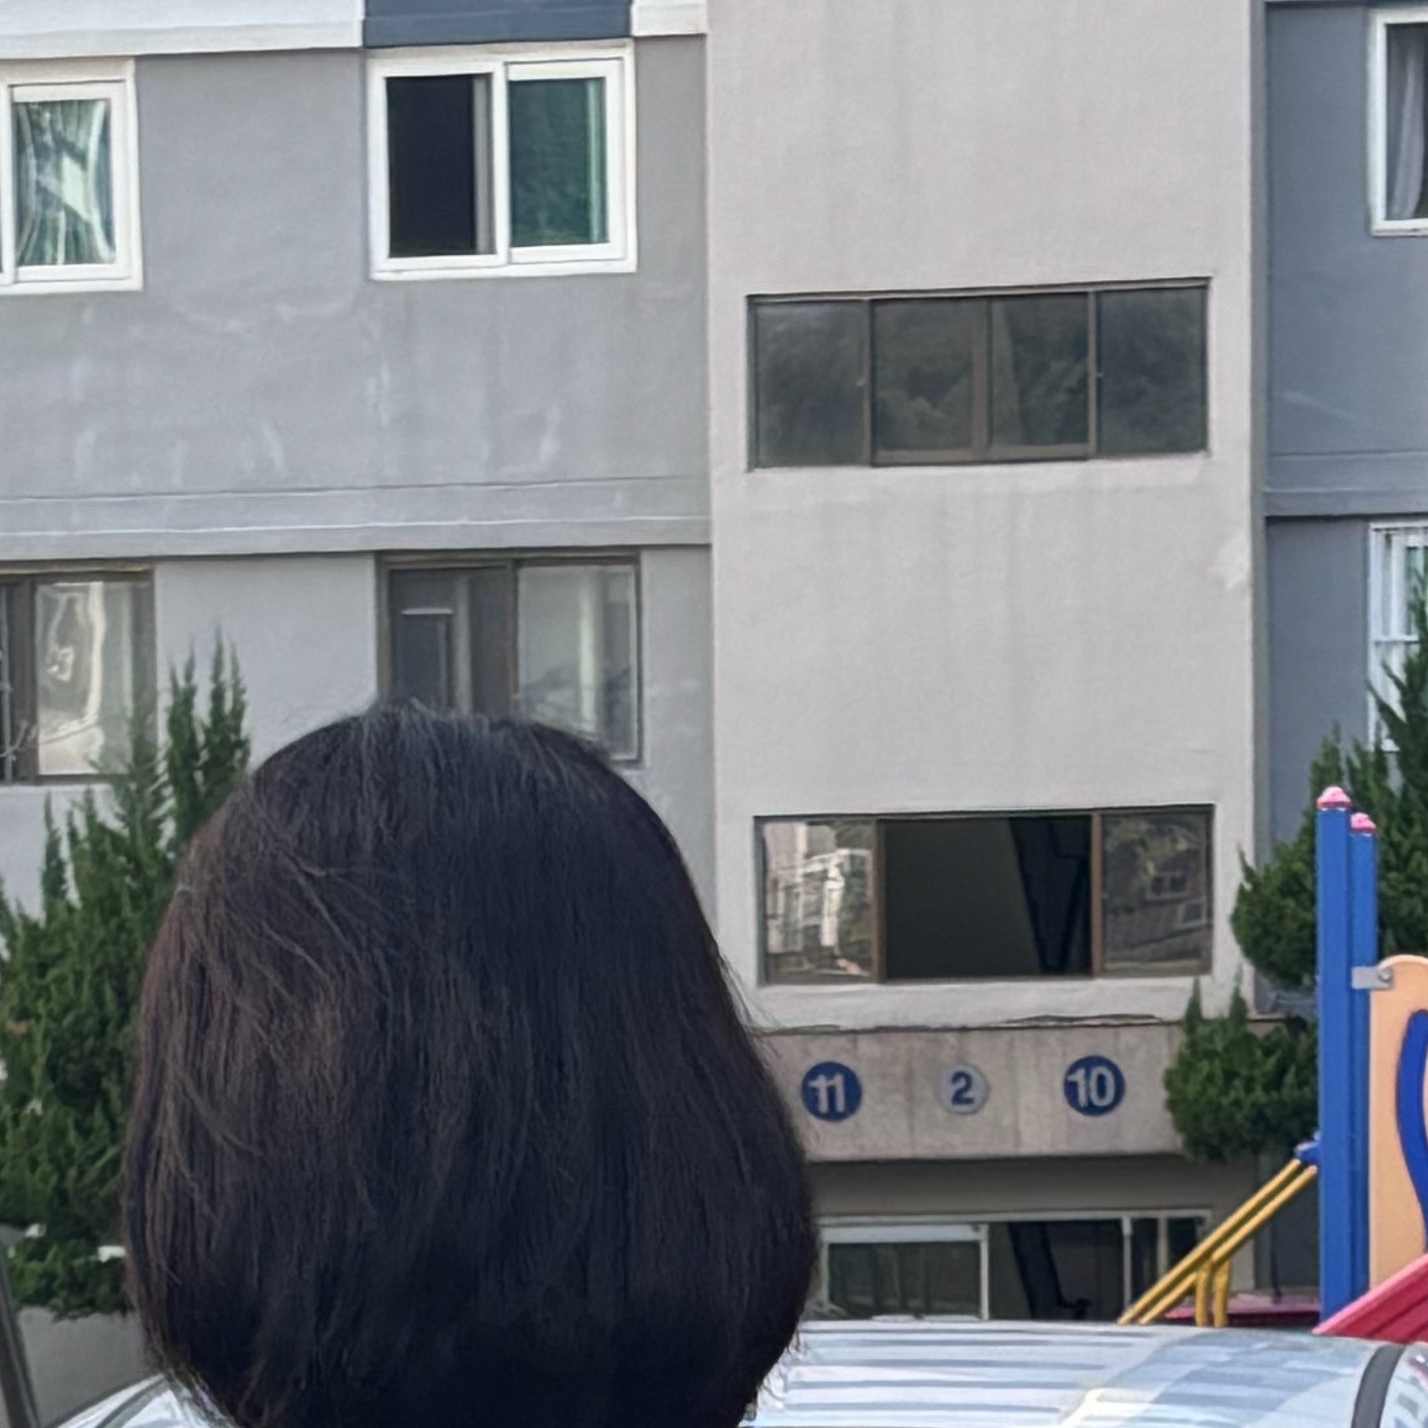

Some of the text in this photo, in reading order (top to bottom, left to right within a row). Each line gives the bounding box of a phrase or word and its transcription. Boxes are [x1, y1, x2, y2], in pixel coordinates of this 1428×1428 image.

[808, 1066, 1117, 1114] 11 2 10
